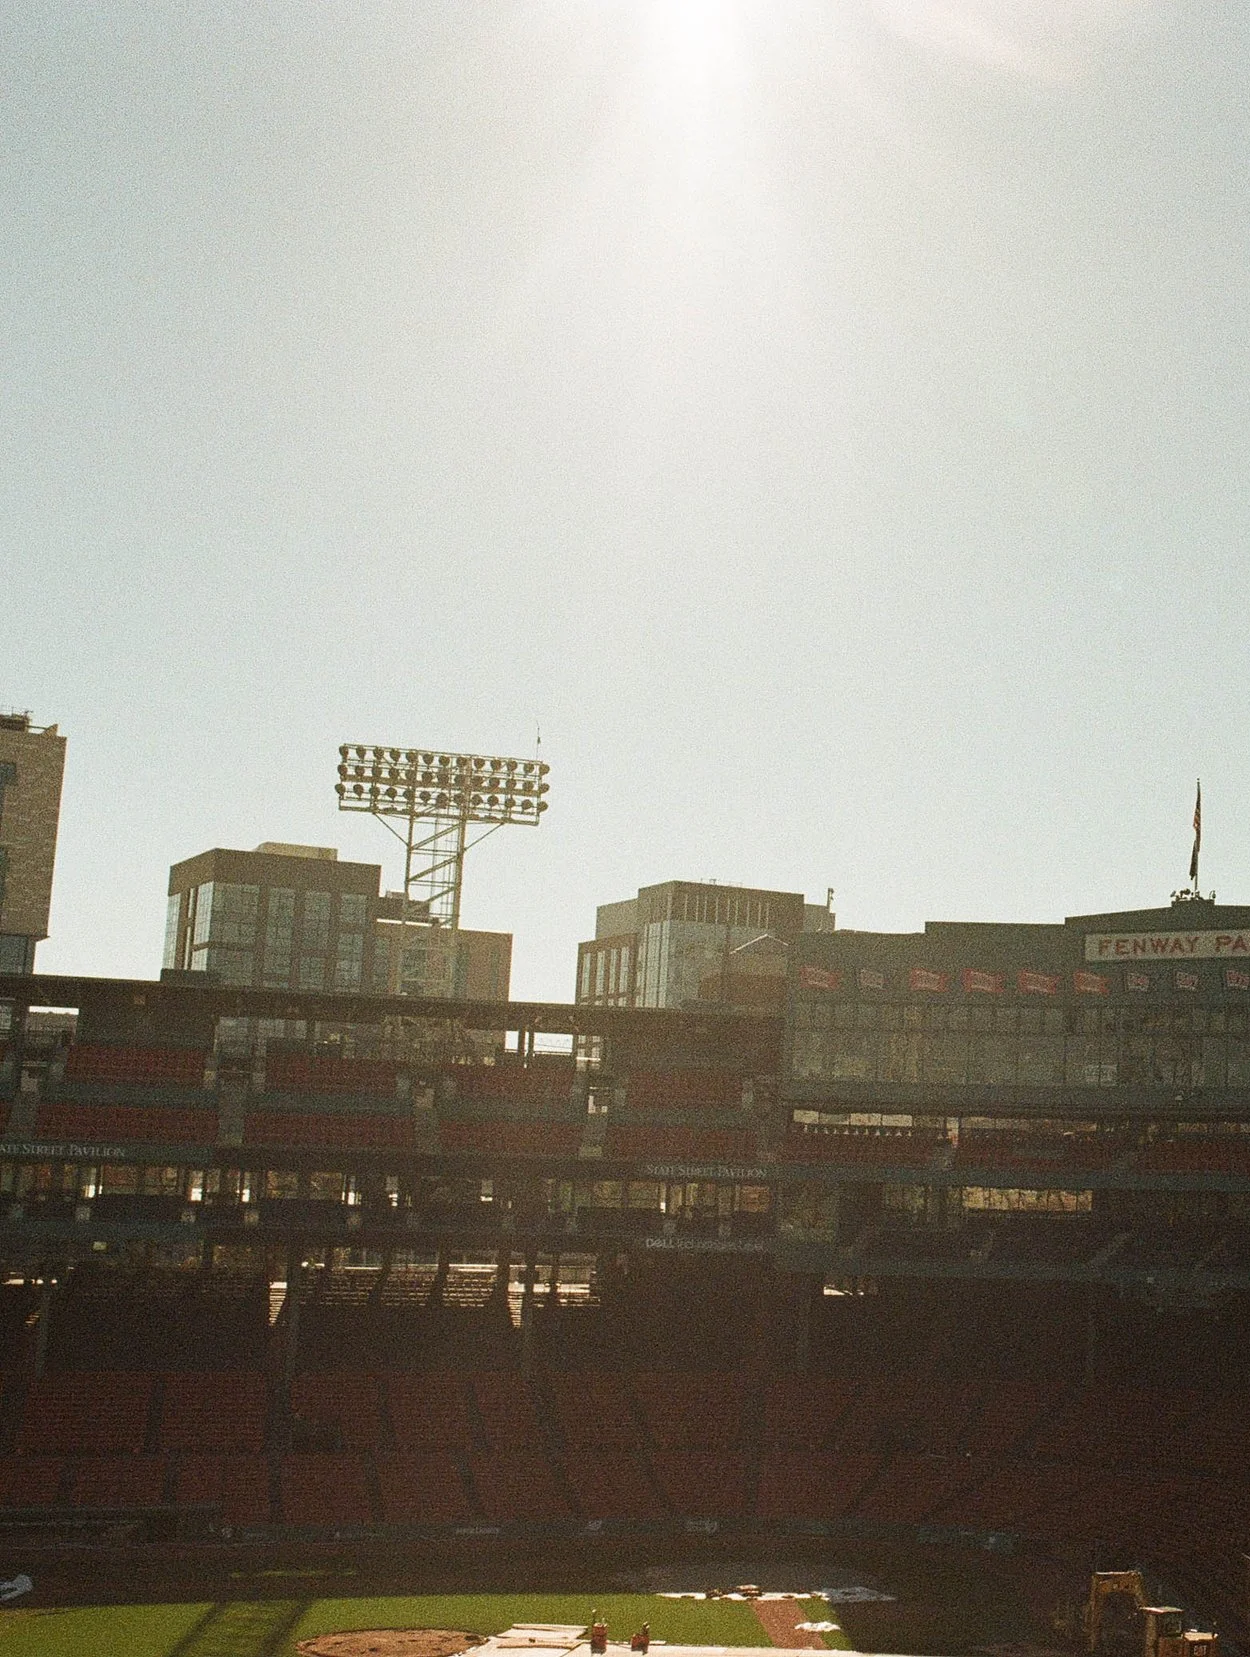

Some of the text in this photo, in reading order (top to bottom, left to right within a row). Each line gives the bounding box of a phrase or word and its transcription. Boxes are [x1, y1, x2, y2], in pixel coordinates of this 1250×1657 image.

[1099, 936, 1199, 955] FENWAY
[22, 1144, 64, 1155] STREET
[69, 1144, 125, 1157] PAVILION
[646, 1164, 767, 1178] STATE STREET PAVILION
